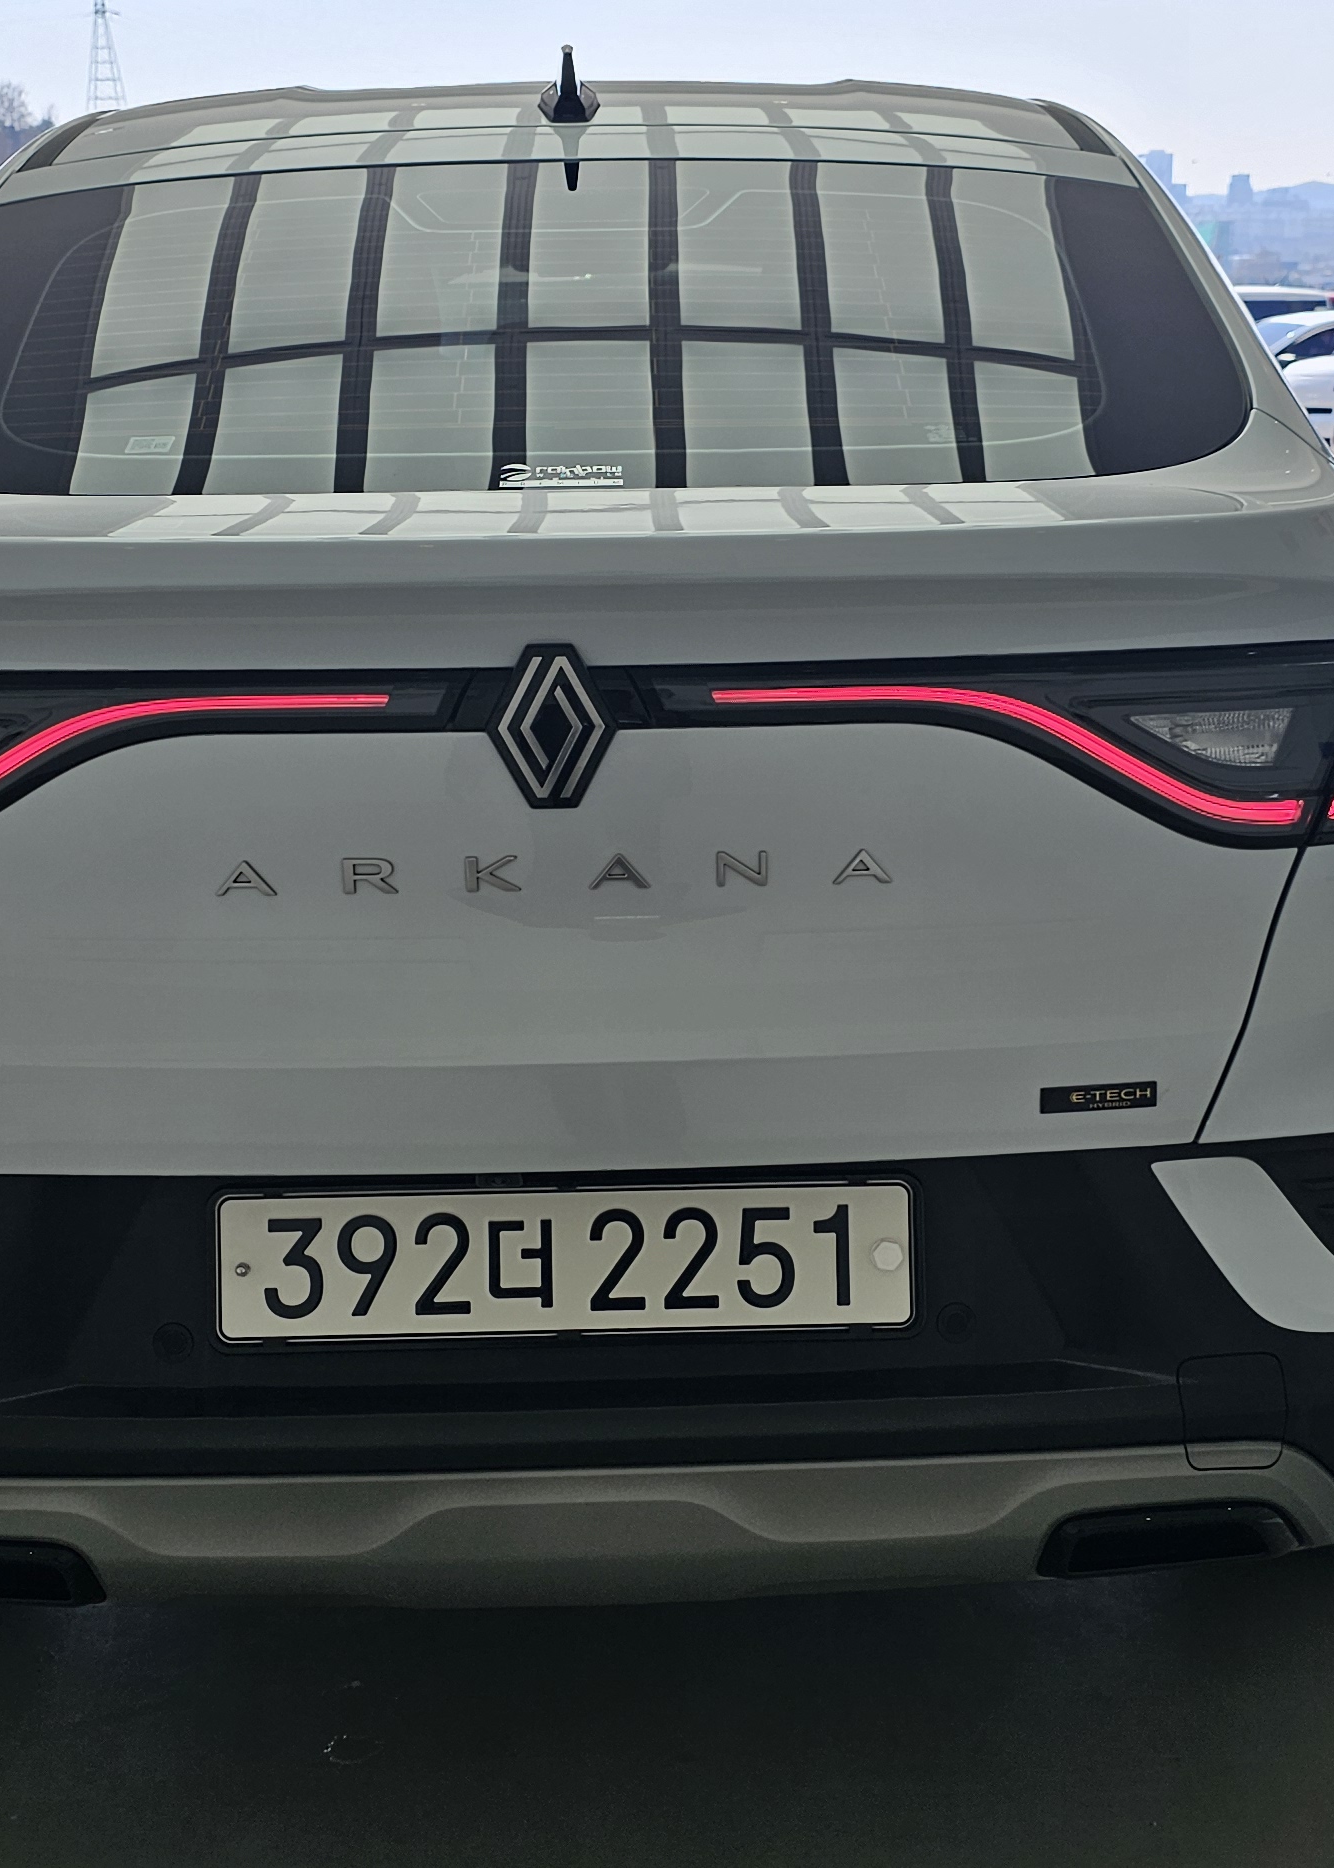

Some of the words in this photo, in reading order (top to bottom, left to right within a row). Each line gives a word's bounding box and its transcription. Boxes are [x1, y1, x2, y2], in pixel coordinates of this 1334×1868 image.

[215, 848, 893, 897] ARKANA
[1069, 1087, 1152, 1103] E-TECH
[1089, 1101, 1131, 1109] HYBRID
[263, 1212, 554, 1320] 392더
[589, 1204, 851, 1311] 2251
